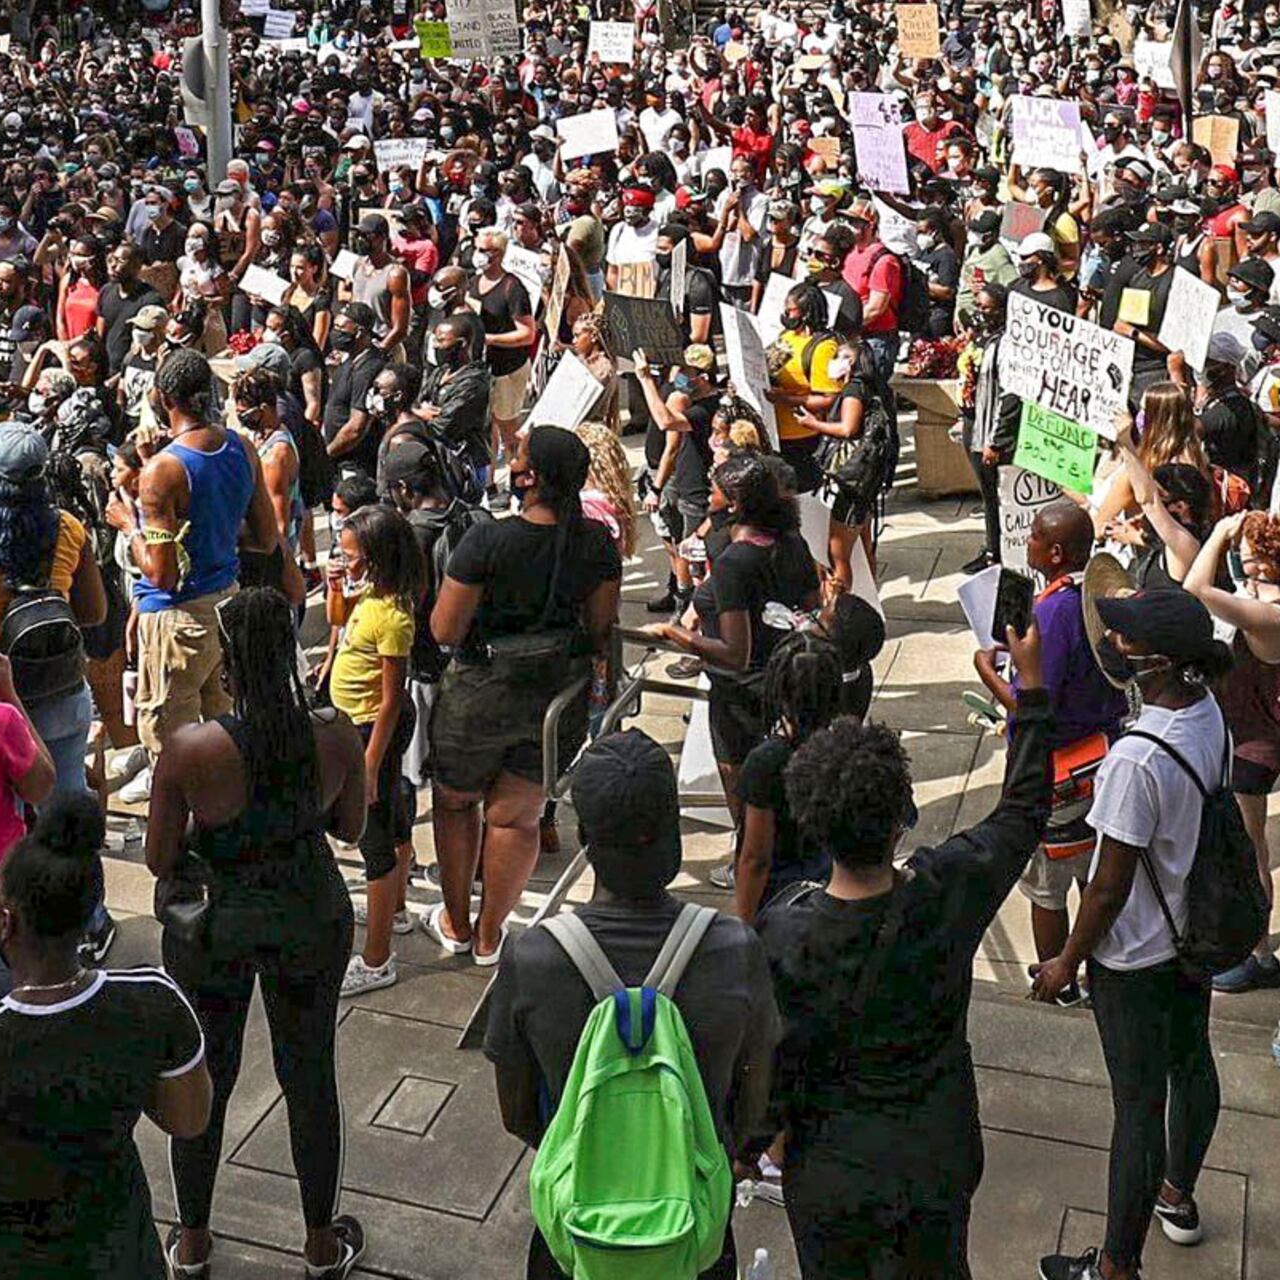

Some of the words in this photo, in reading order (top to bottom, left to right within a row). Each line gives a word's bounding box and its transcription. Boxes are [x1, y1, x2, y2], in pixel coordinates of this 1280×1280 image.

[1037, 304, 1075, 334] YOU
[1010, 319, 1102, 372] COURAGE
[1012, 341, 1035, 362] TO
[1036, 369, 1092, 423] HEAR
[1020, 471, 1061, 501] STO
